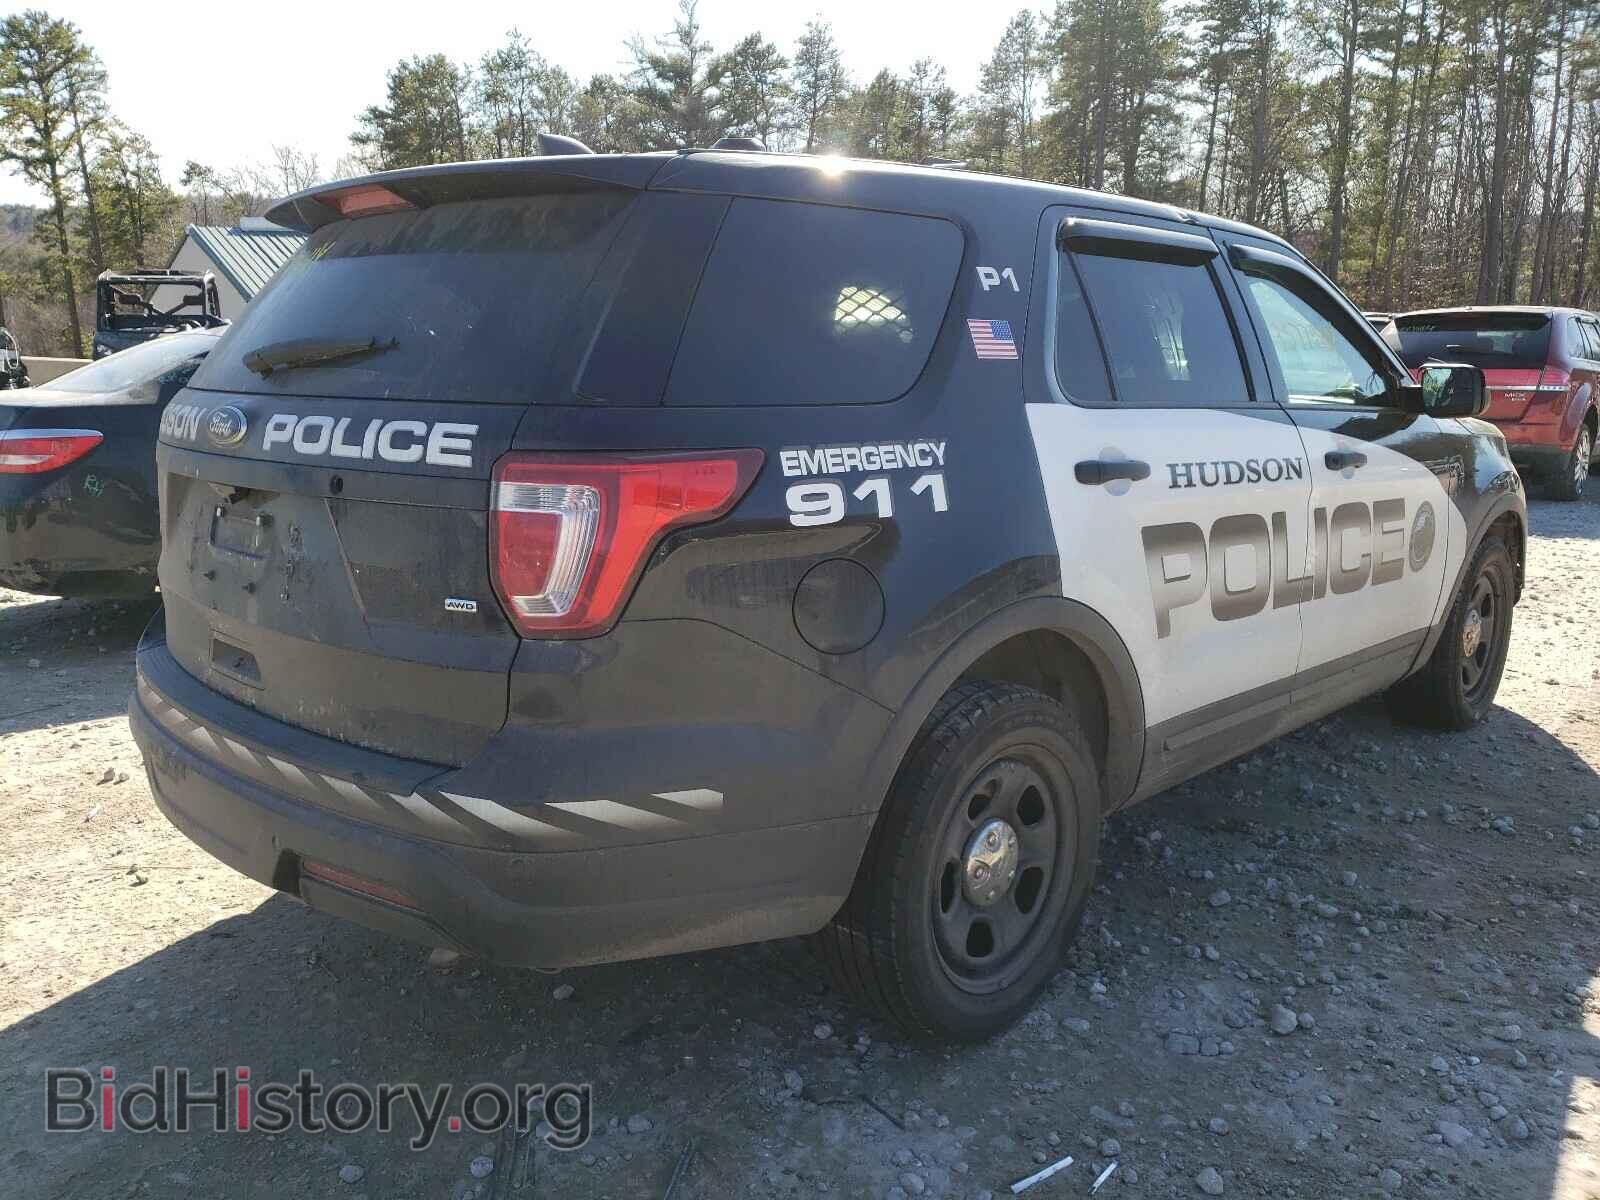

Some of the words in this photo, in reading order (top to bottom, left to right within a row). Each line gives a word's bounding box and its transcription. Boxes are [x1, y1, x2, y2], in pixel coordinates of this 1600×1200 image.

[975, 266, 1021, 292] P1
[209, 411, 233, 437] Ford
[263, 414, 479, 468] POLICE
[779, 441, 948, 478] EMERGENCY
[1166, 457, 1304, 489] HUDSON
[784, 474, 950, 527] 911
[1140, 498, 1406, 640] POLICE
[447, 601, 474, 610] AWD
